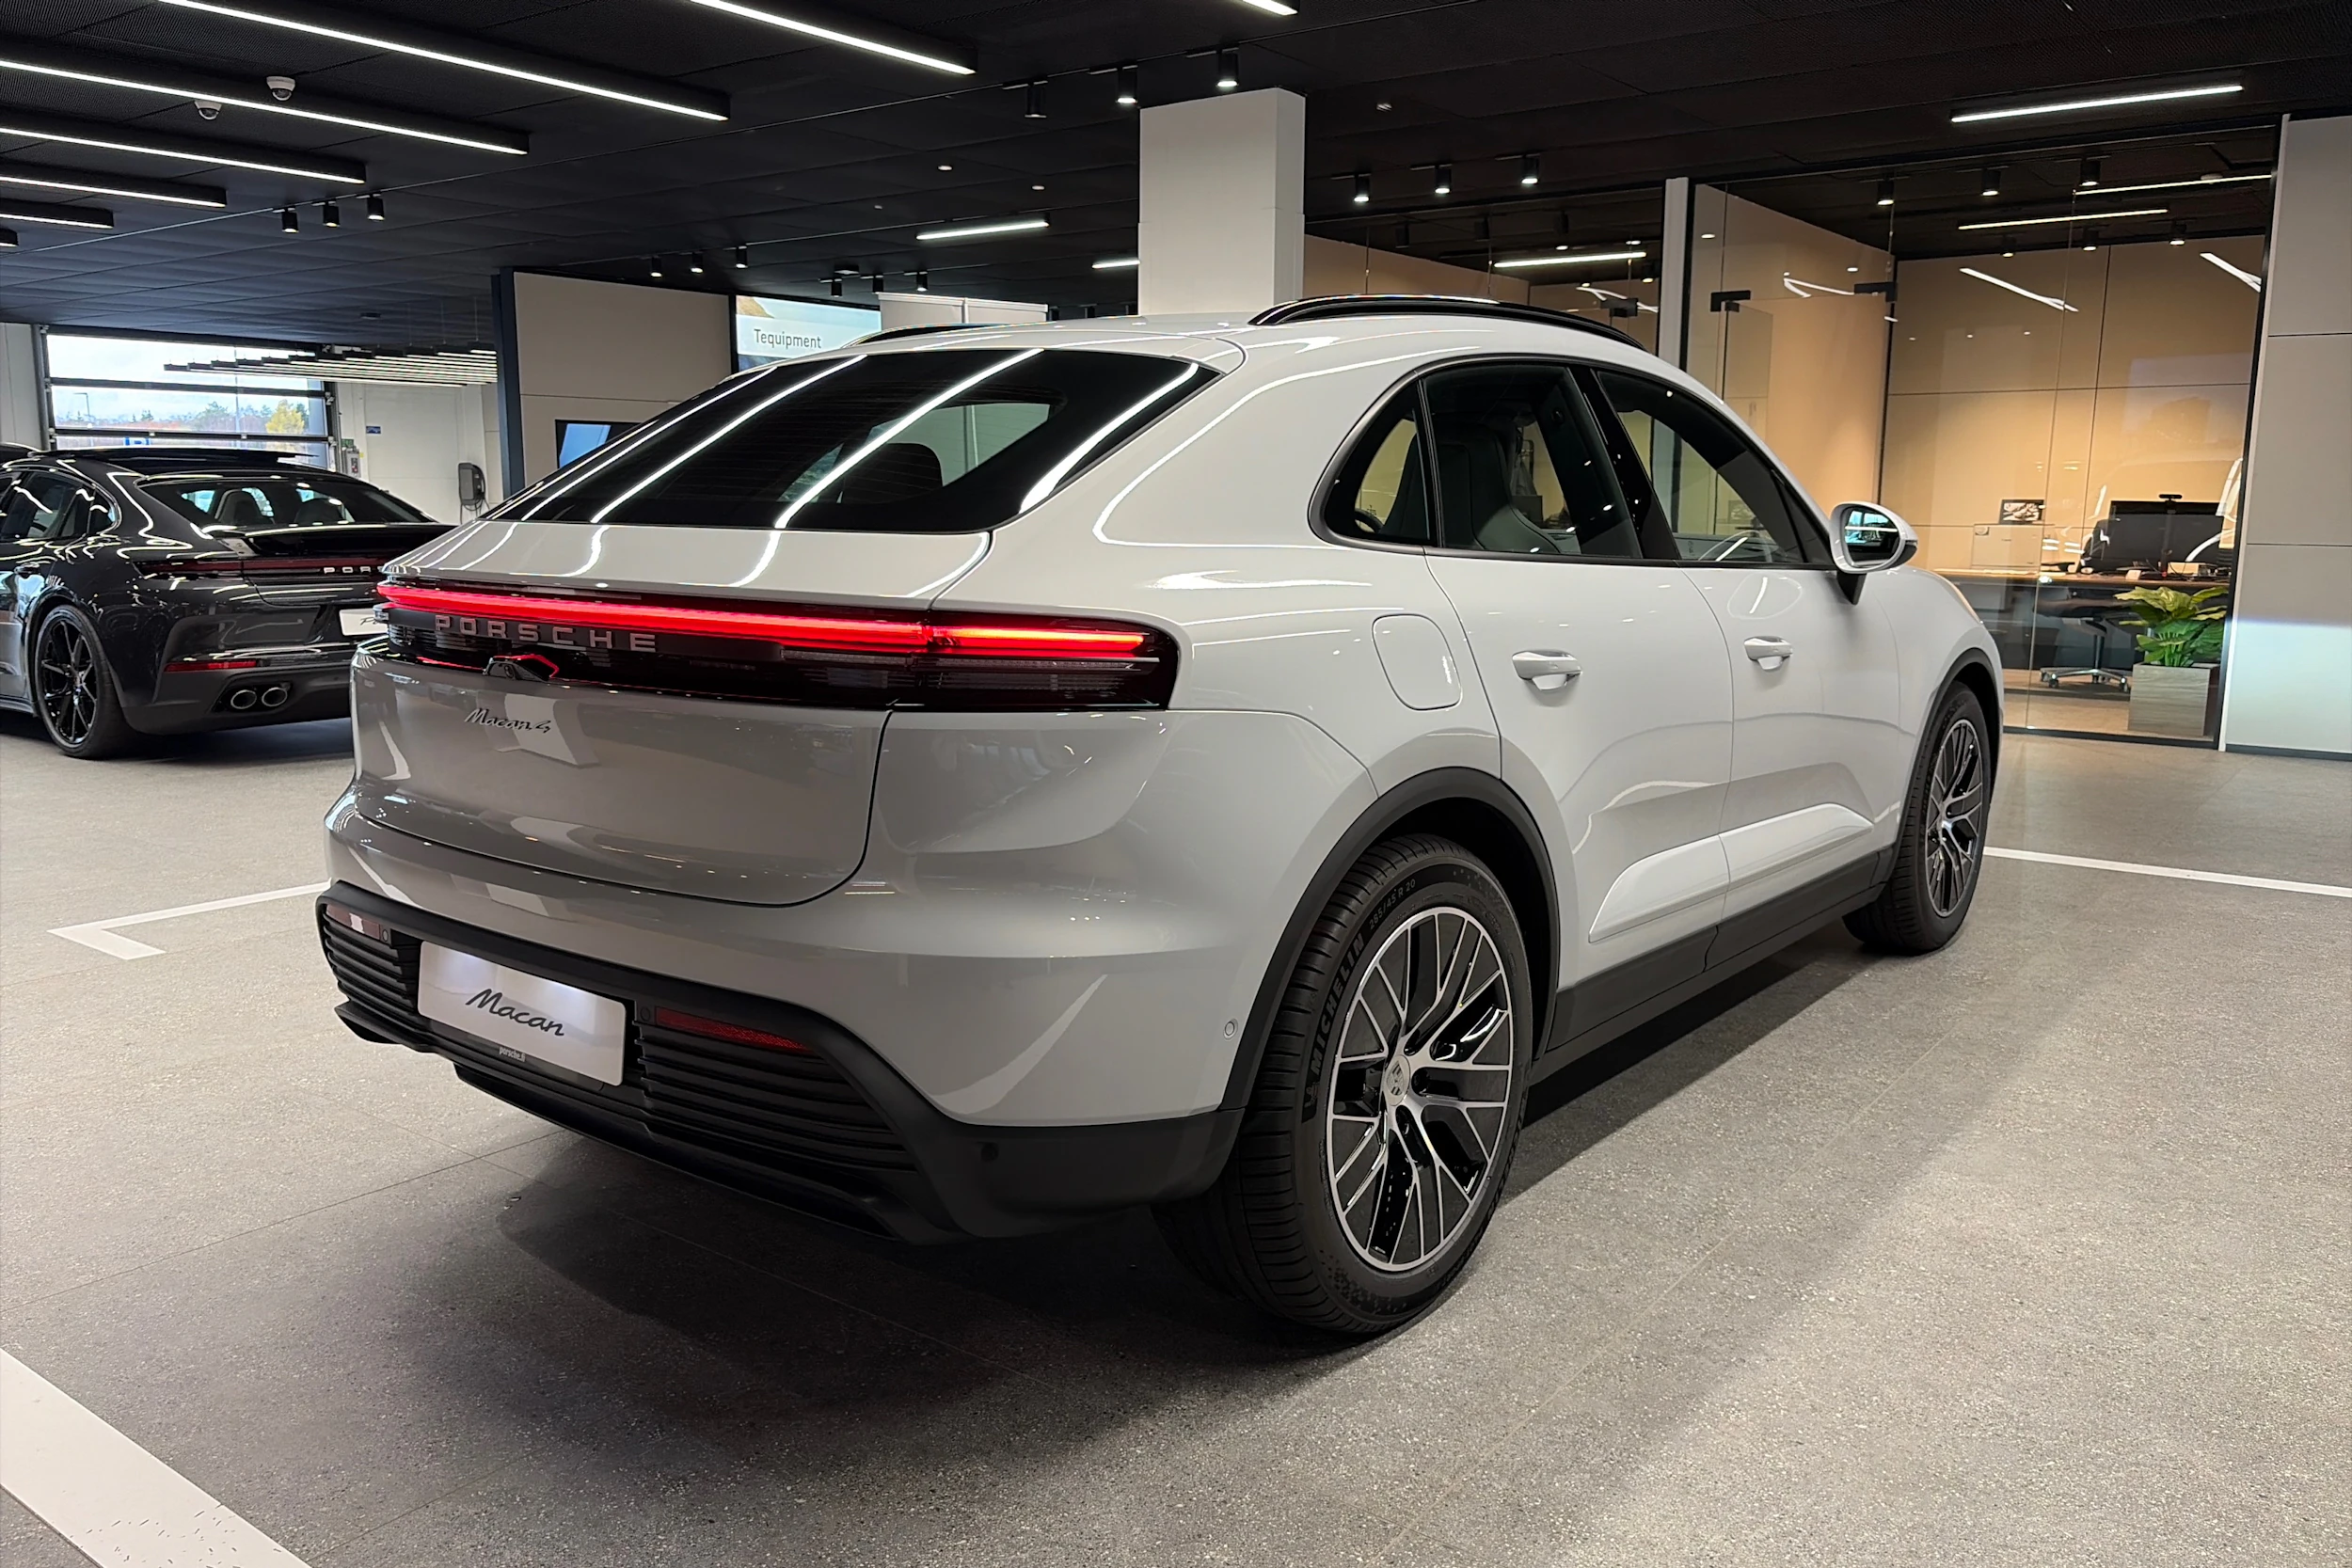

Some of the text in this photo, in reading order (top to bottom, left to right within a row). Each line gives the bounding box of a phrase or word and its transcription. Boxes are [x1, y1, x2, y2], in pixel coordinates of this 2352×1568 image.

[754, 328, 822, 350] Tequipment
[435, 614, 656, 653] PORSCHE
[464, 707, 532, 731] Macan
[1369, 895, 1397, 930] 285/45
[1398, 887, 1404, 898] R
[465, 988, 564, 1037] Macan
[1311, 932, 1365, 1075] MICHELIN
[499, 1046, 526, 1063] porsche.fi
